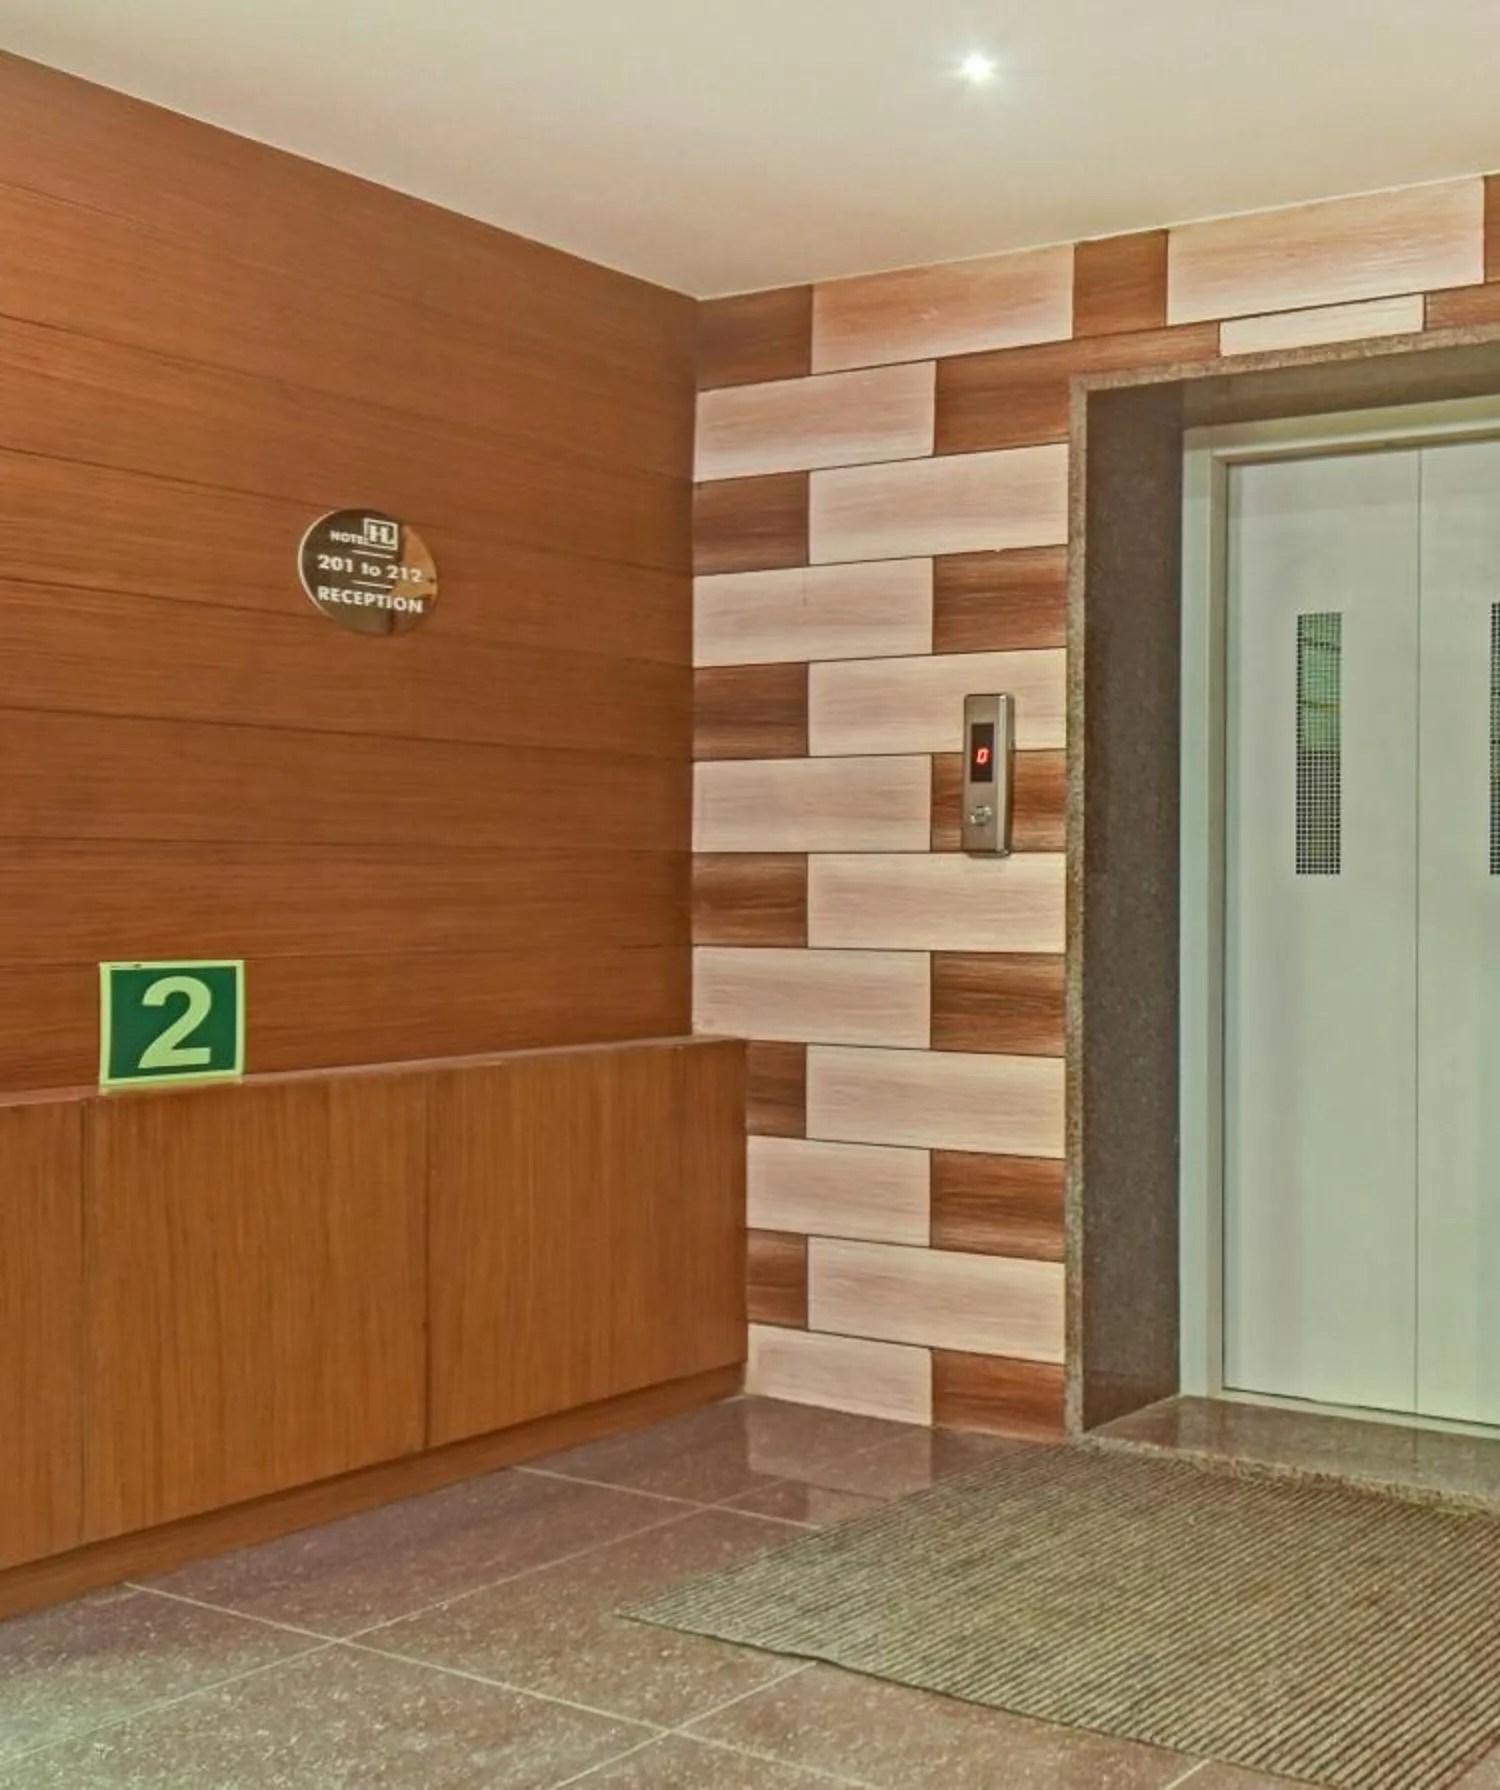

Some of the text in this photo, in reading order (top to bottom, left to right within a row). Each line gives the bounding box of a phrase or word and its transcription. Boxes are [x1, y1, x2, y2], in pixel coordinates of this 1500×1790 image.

[317, 554, 423, 583] 201 to 212
[317, 586, 424, 613] RECEPTION
[137, 975, 212, 1069] 2
